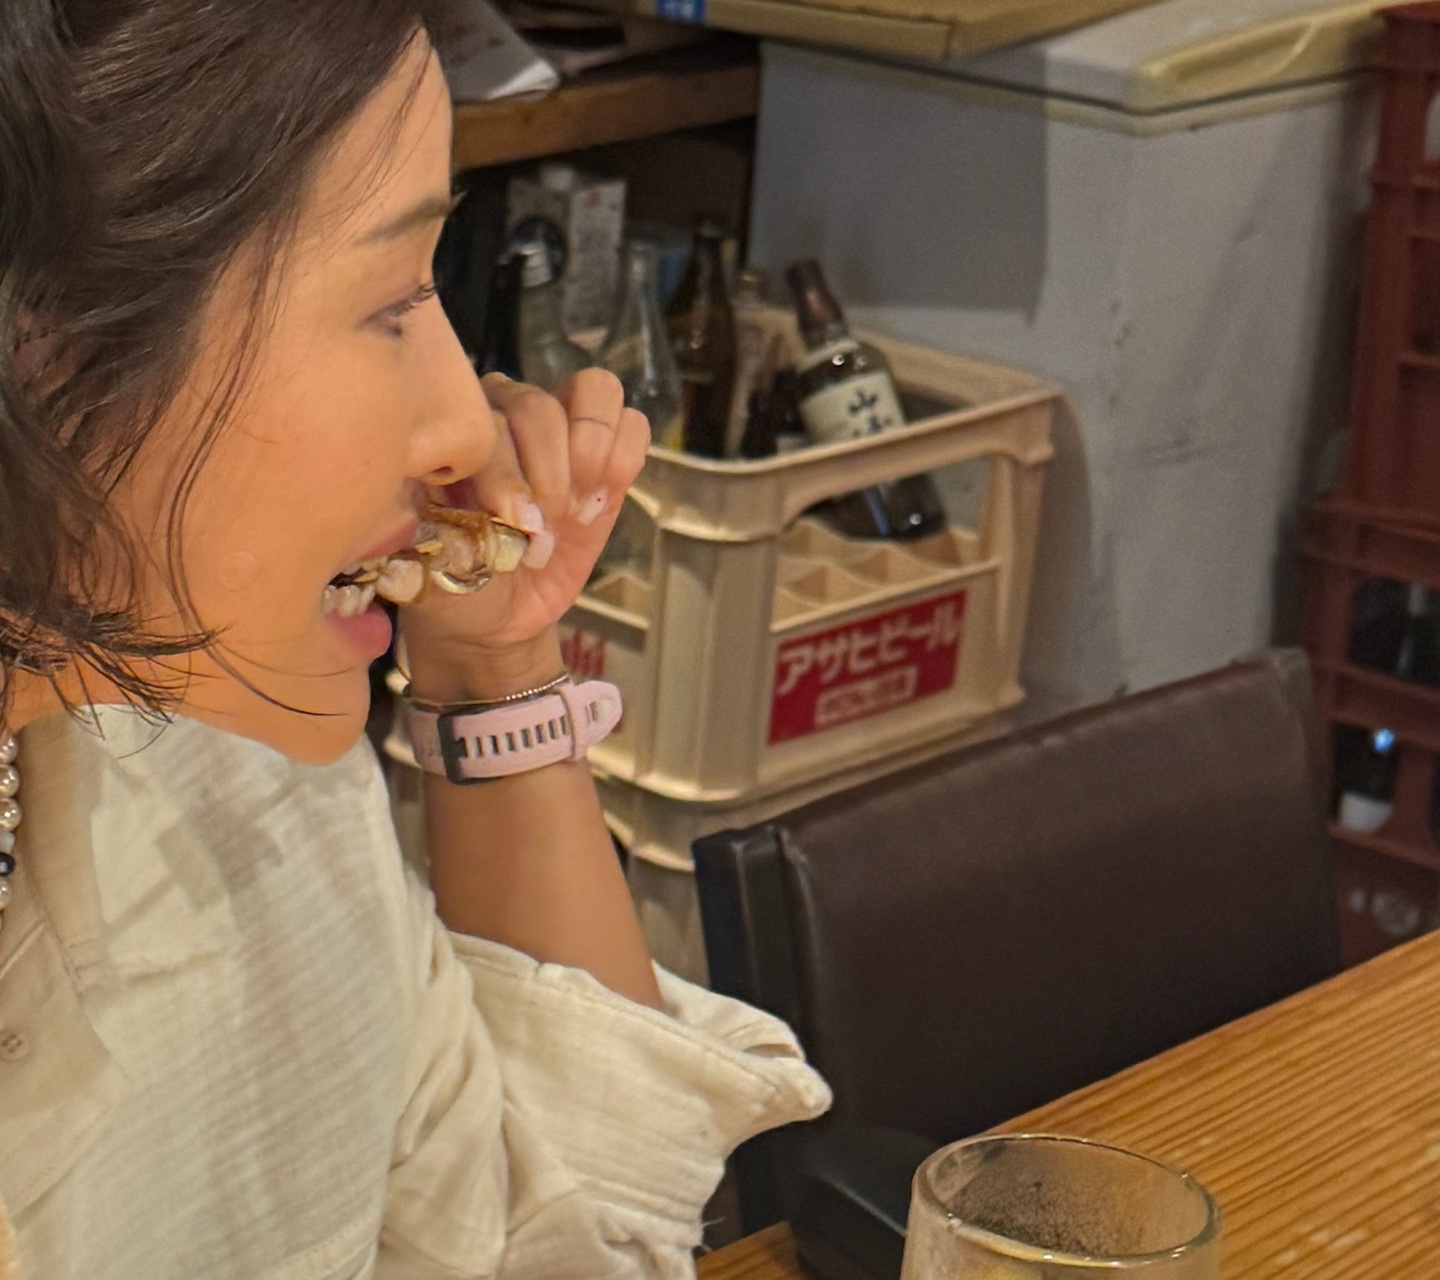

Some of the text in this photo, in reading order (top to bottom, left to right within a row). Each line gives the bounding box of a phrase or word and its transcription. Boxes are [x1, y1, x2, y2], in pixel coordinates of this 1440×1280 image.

[776, 600, 958, 695] アサヒビール
